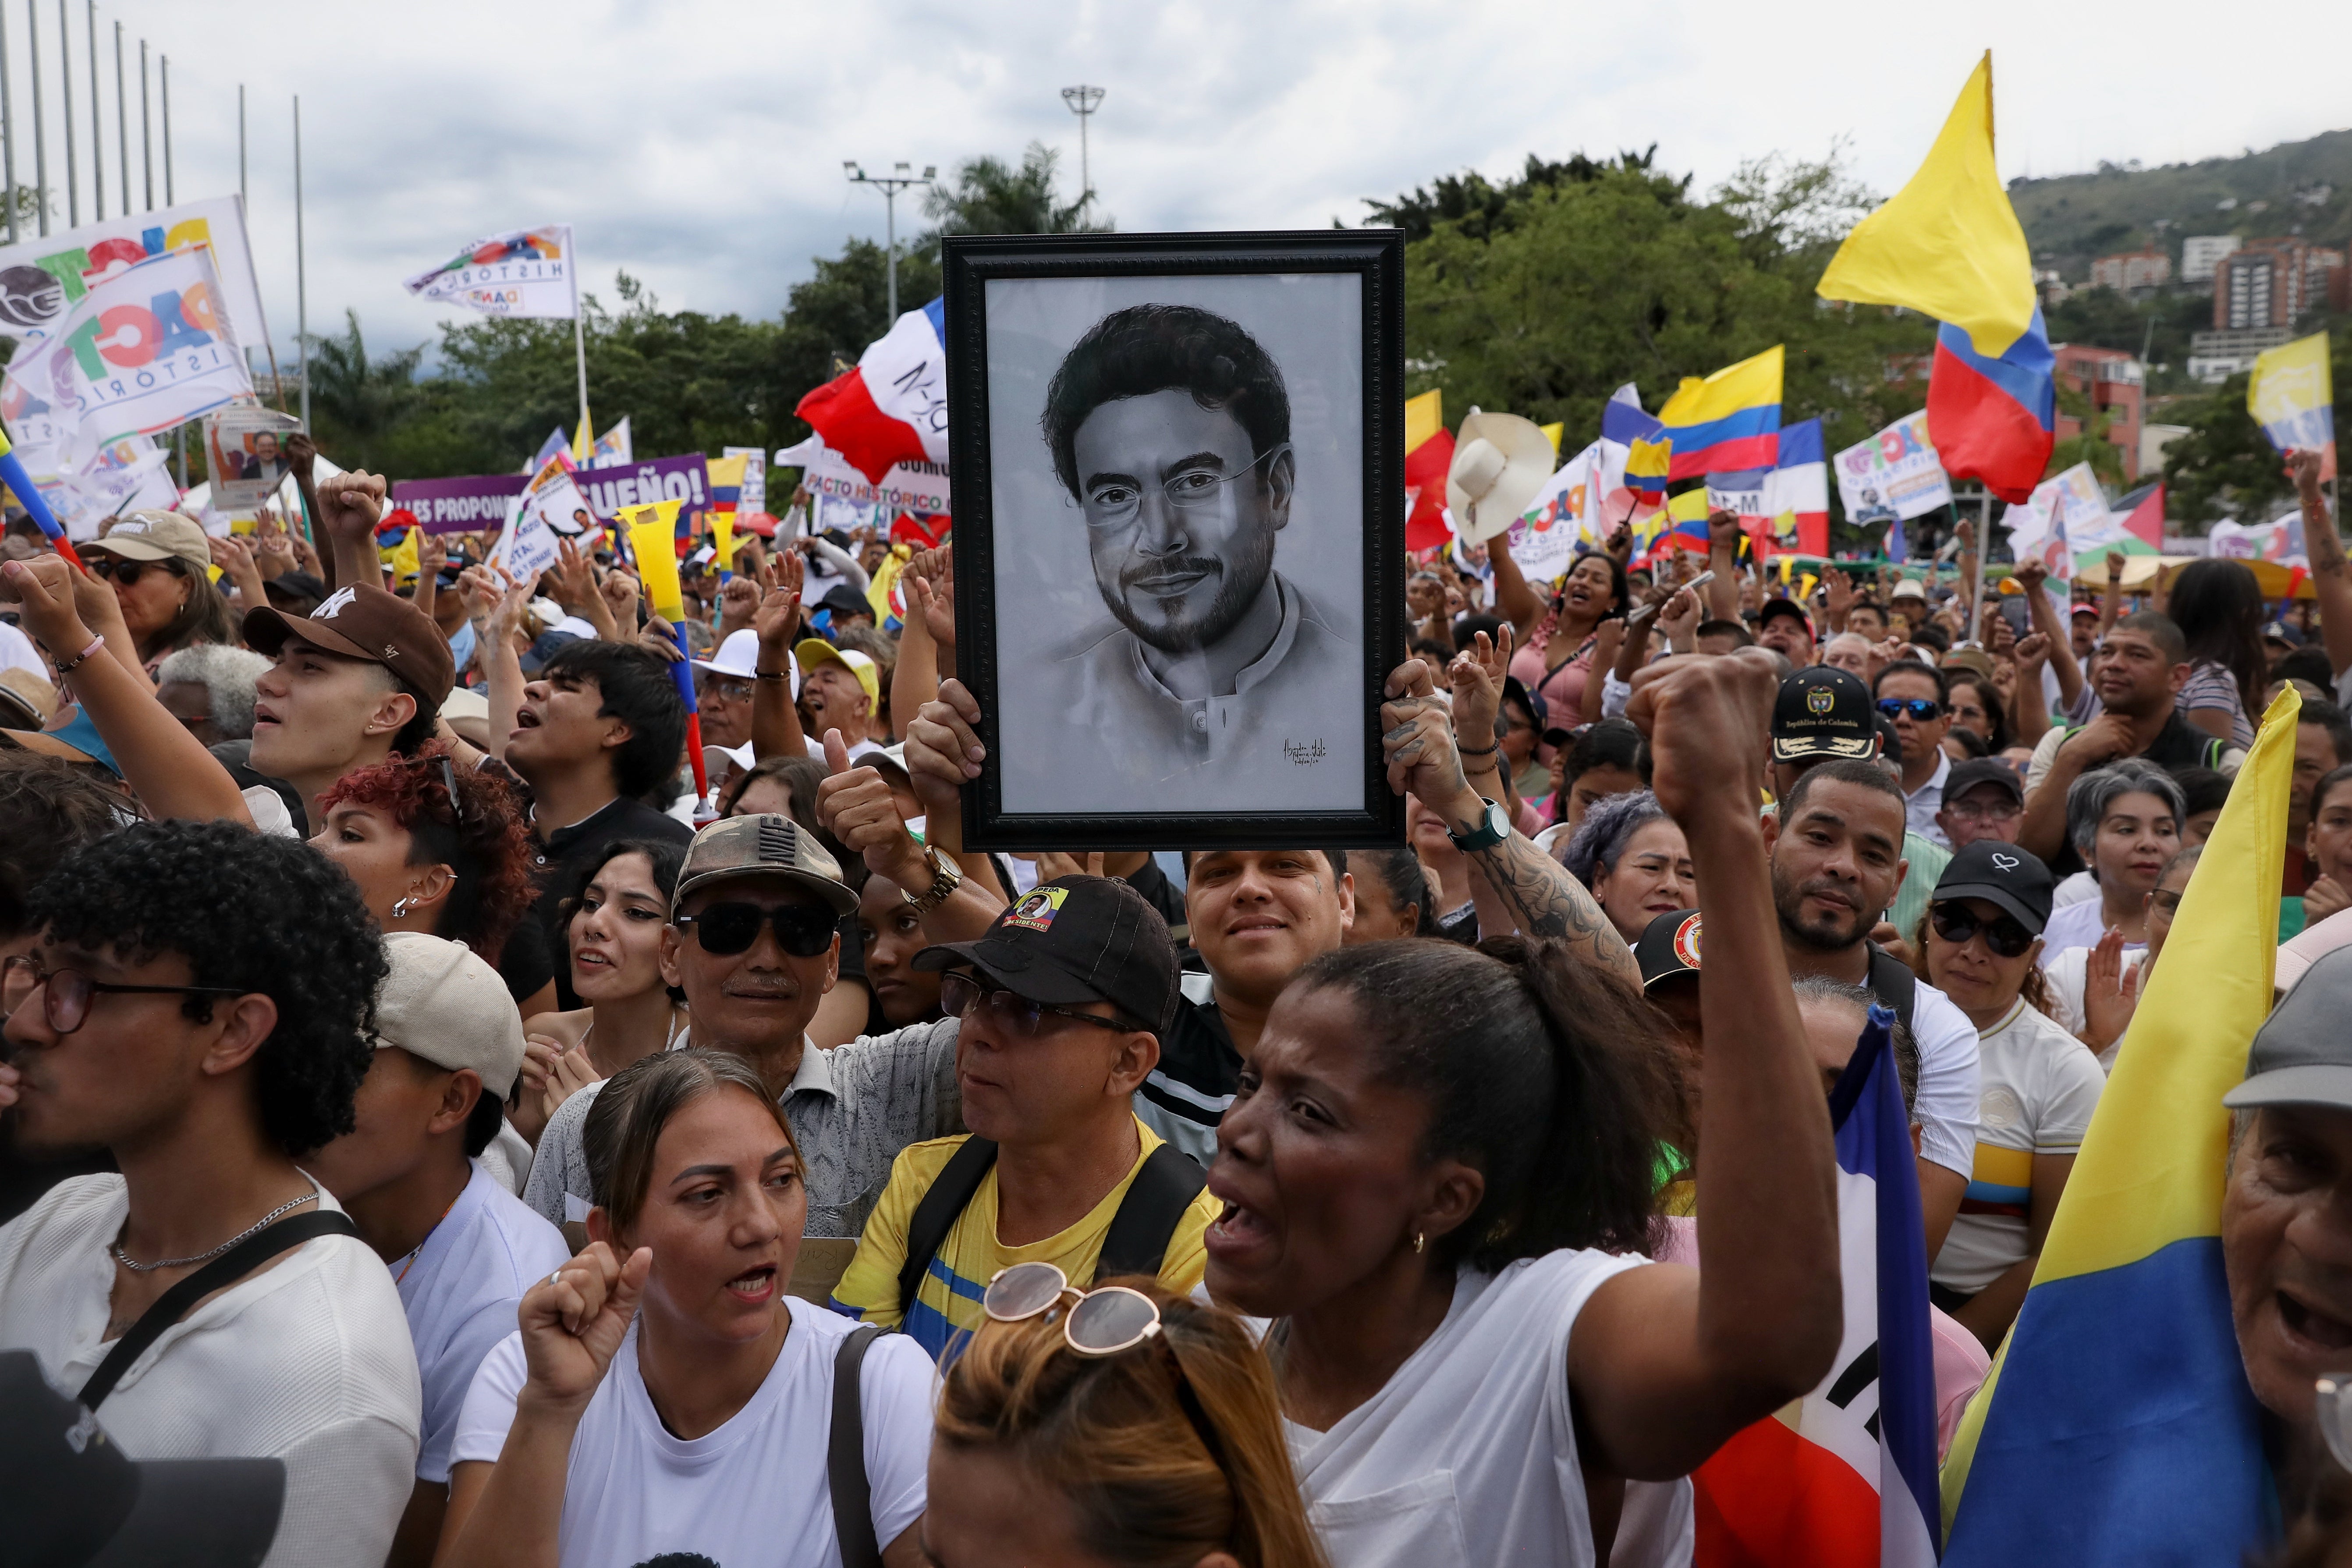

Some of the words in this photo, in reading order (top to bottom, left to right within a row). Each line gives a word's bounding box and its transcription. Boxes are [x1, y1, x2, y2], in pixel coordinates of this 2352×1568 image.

[578, 465, 706, 519] UEÑO!
[807, 473, 852, 496] PACTO
[856, 483, 941, 510] HISTÓRICO
[309, 586, 356, 619] NY
